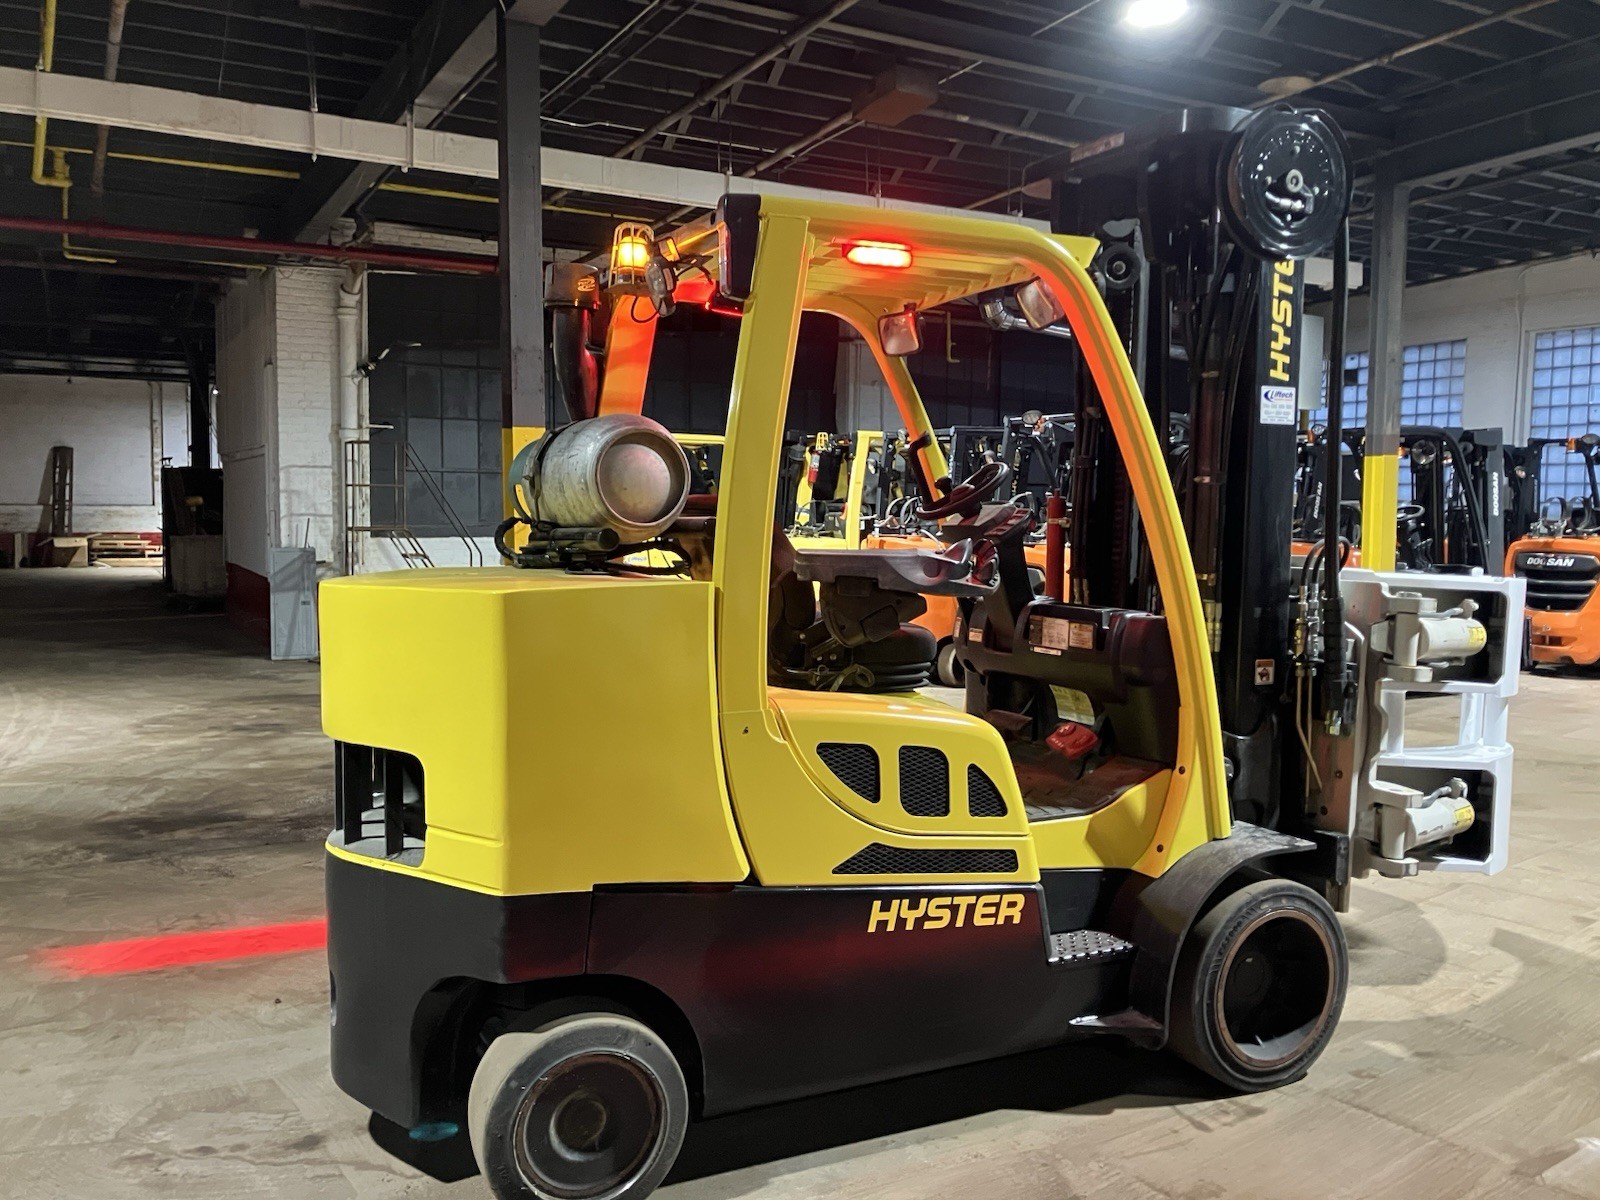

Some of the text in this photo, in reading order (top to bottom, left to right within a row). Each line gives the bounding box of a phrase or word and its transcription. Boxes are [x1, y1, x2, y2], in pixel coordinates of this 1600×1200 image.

[1269, 390, 1294, 400] Liftech
[1492, 471, 1500, 517] DOOSAN
[867, 893, 1026, 933] HYSTER
